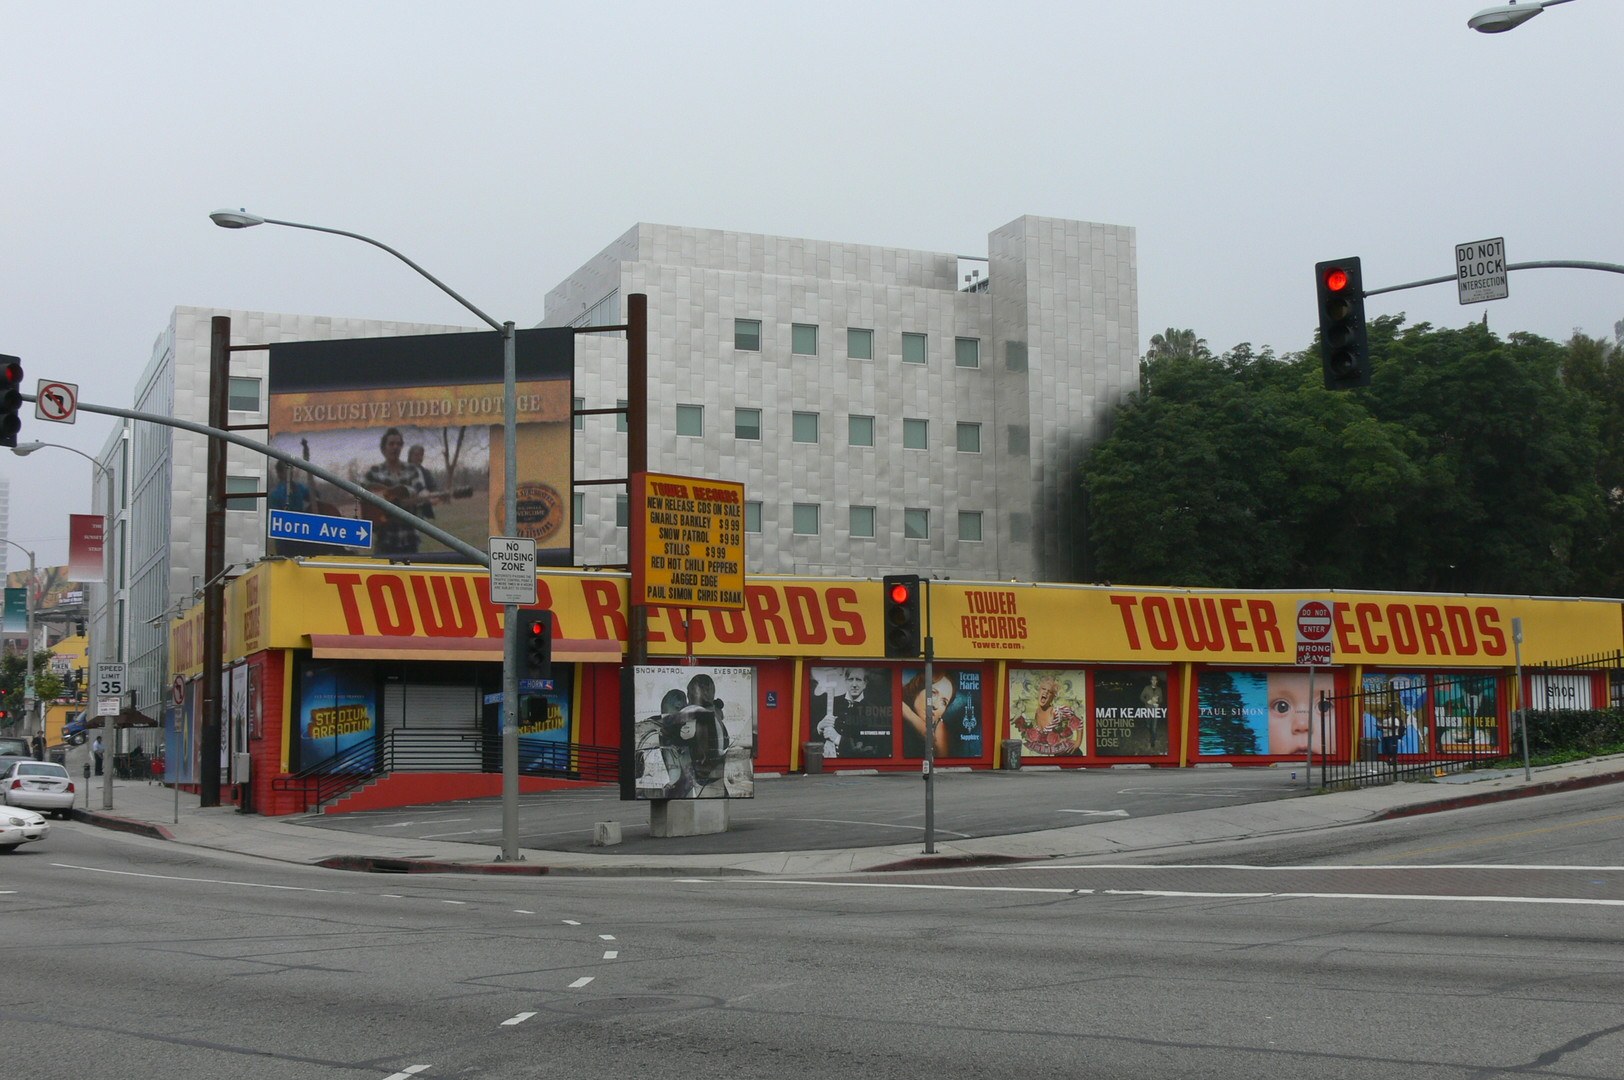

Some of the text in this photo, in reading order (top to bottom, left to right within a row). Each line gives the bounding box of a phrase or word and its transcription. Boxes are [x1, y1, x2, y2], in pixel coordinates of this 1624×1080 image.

[1459, 242, 1501, 262] DO NOT
[1460, 259, 1503, 279] BLOCK
[1460, 276, 1505, 291] INTERSECTION
[292, 394, 541, 423] EXCLUSIVE VIDEO FOOTGE
[650, 481, 739, 504] TOWER RECORDS
[647, 497, 663, 509] NEW
[665, 499, 695, 513] RELEASE
[713, 503, 722, 515] ON
[723, 504, 741, 517] SALE
[650, 511, 678, 526] GNARLS
[680, 515, 711, 529] BARKLEY
[272, 517, 347, 539] Horn Ave
[659, 527, 679, 541] SNOW
[682, 530, 709, 543] PATROL
[506, 543, 519, 551] NO
[664, 542, 690, 556] STILLS
[492, 552, 533, 562] CRUISING
[501, 562, 525, 571] ZONE
[651, 556, 738, 574] RED HOT CHILI PEPPERS
[671, 573, 718, 587] JAGGED EDGE
[647, 586, 666, 599] PAUL
[668, 587, 692, 600] SIMON
[697, 589, 718, 602] CHRIS
[964, 591, 1017, 614] TOWER
[961, 615, 1028, 639] RECORDS
[1109, 595, 1507, 657] TOWER ECORDS
[657, 667, 684, 675] PATROL
[100, 681, 121, 694] 35
[527, 680, 543, 688] HORN
[959, 680, 980, 690] Marie
[1547, 683, 1575, 700] shop
[1095, 707, 1168, 718] MAT KEARNEY
[1231, 708, 1264, 716] SIMON
[1096, 719, 1135, 728] NOTHING
[1096, 728, 1131, 738] LEFT TO
[1096, 738, 1119, 747] LOSE
